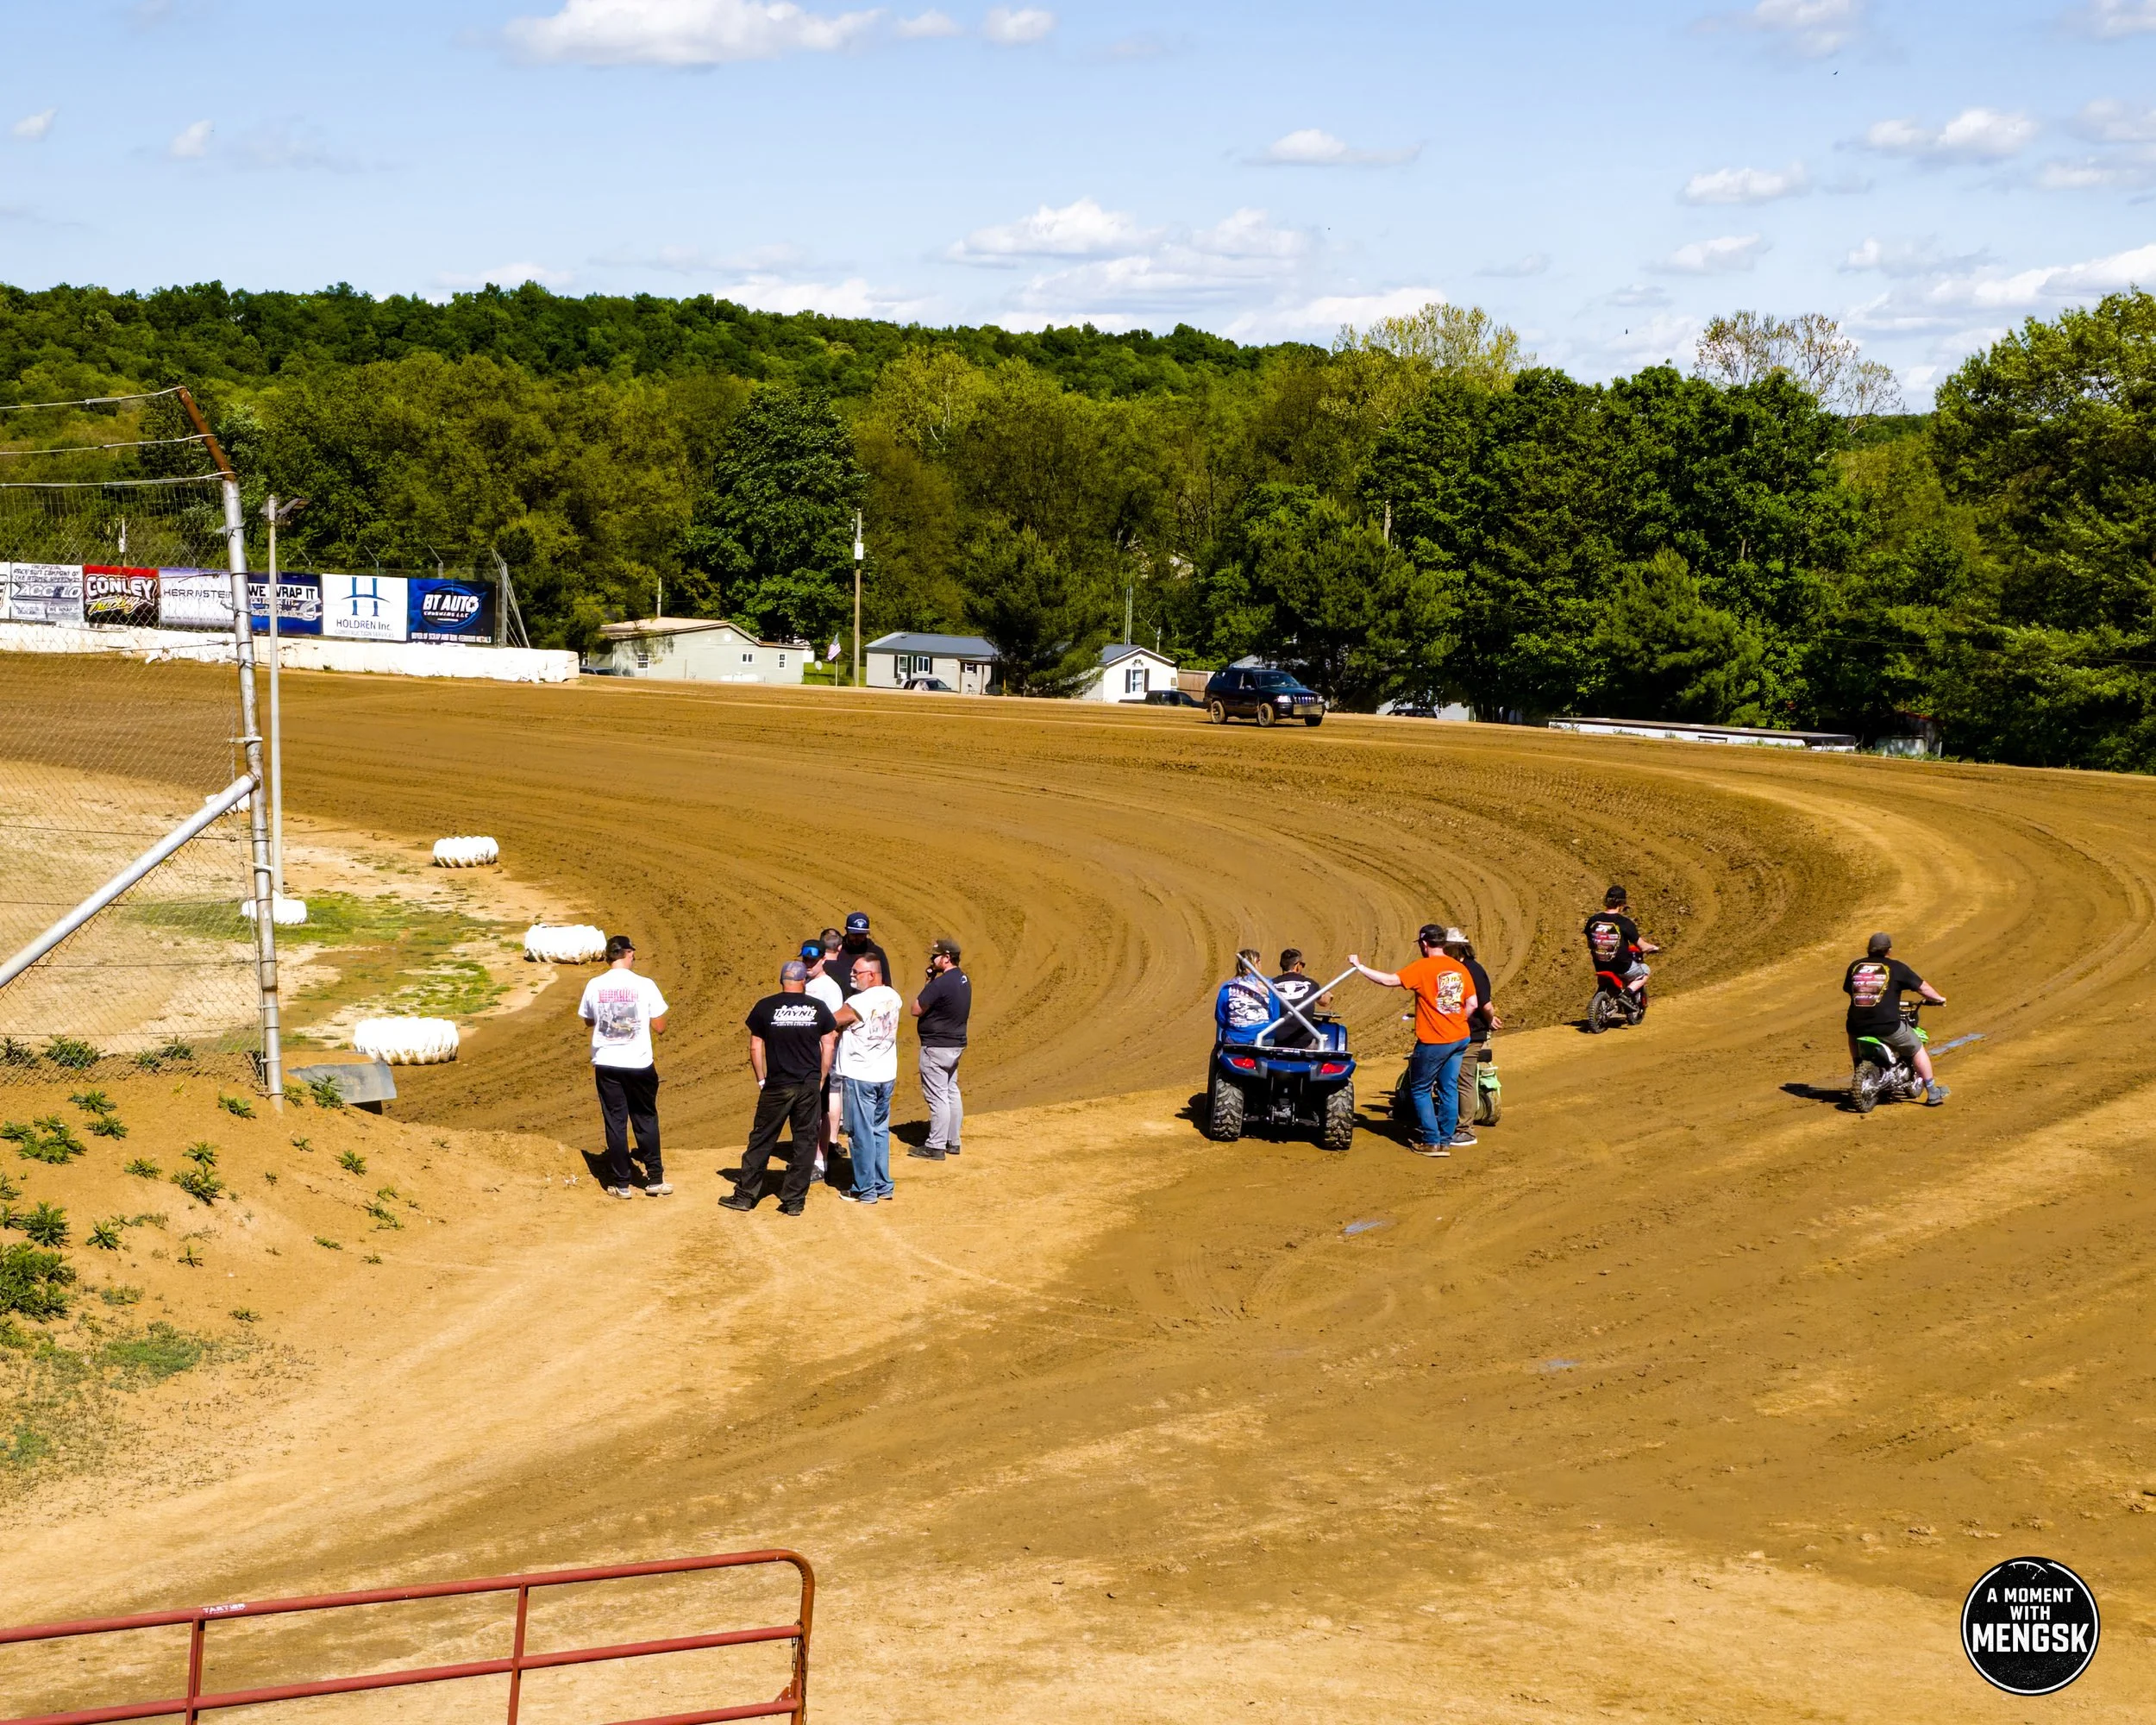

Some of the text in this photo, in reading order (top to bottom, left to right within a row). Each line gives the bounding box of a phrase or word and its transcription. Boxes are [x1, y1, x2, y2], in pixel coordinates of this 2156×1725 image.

[85, 575, 154, 602] CONLEY
[248, 585, 266, 597] WE
[305, 588, 316, 599] IT
[87, 595, 140, 616] Trucking
[423, 594, 479, 613] BT AUTO
[336, 619, 376, 630] HOLDREN
